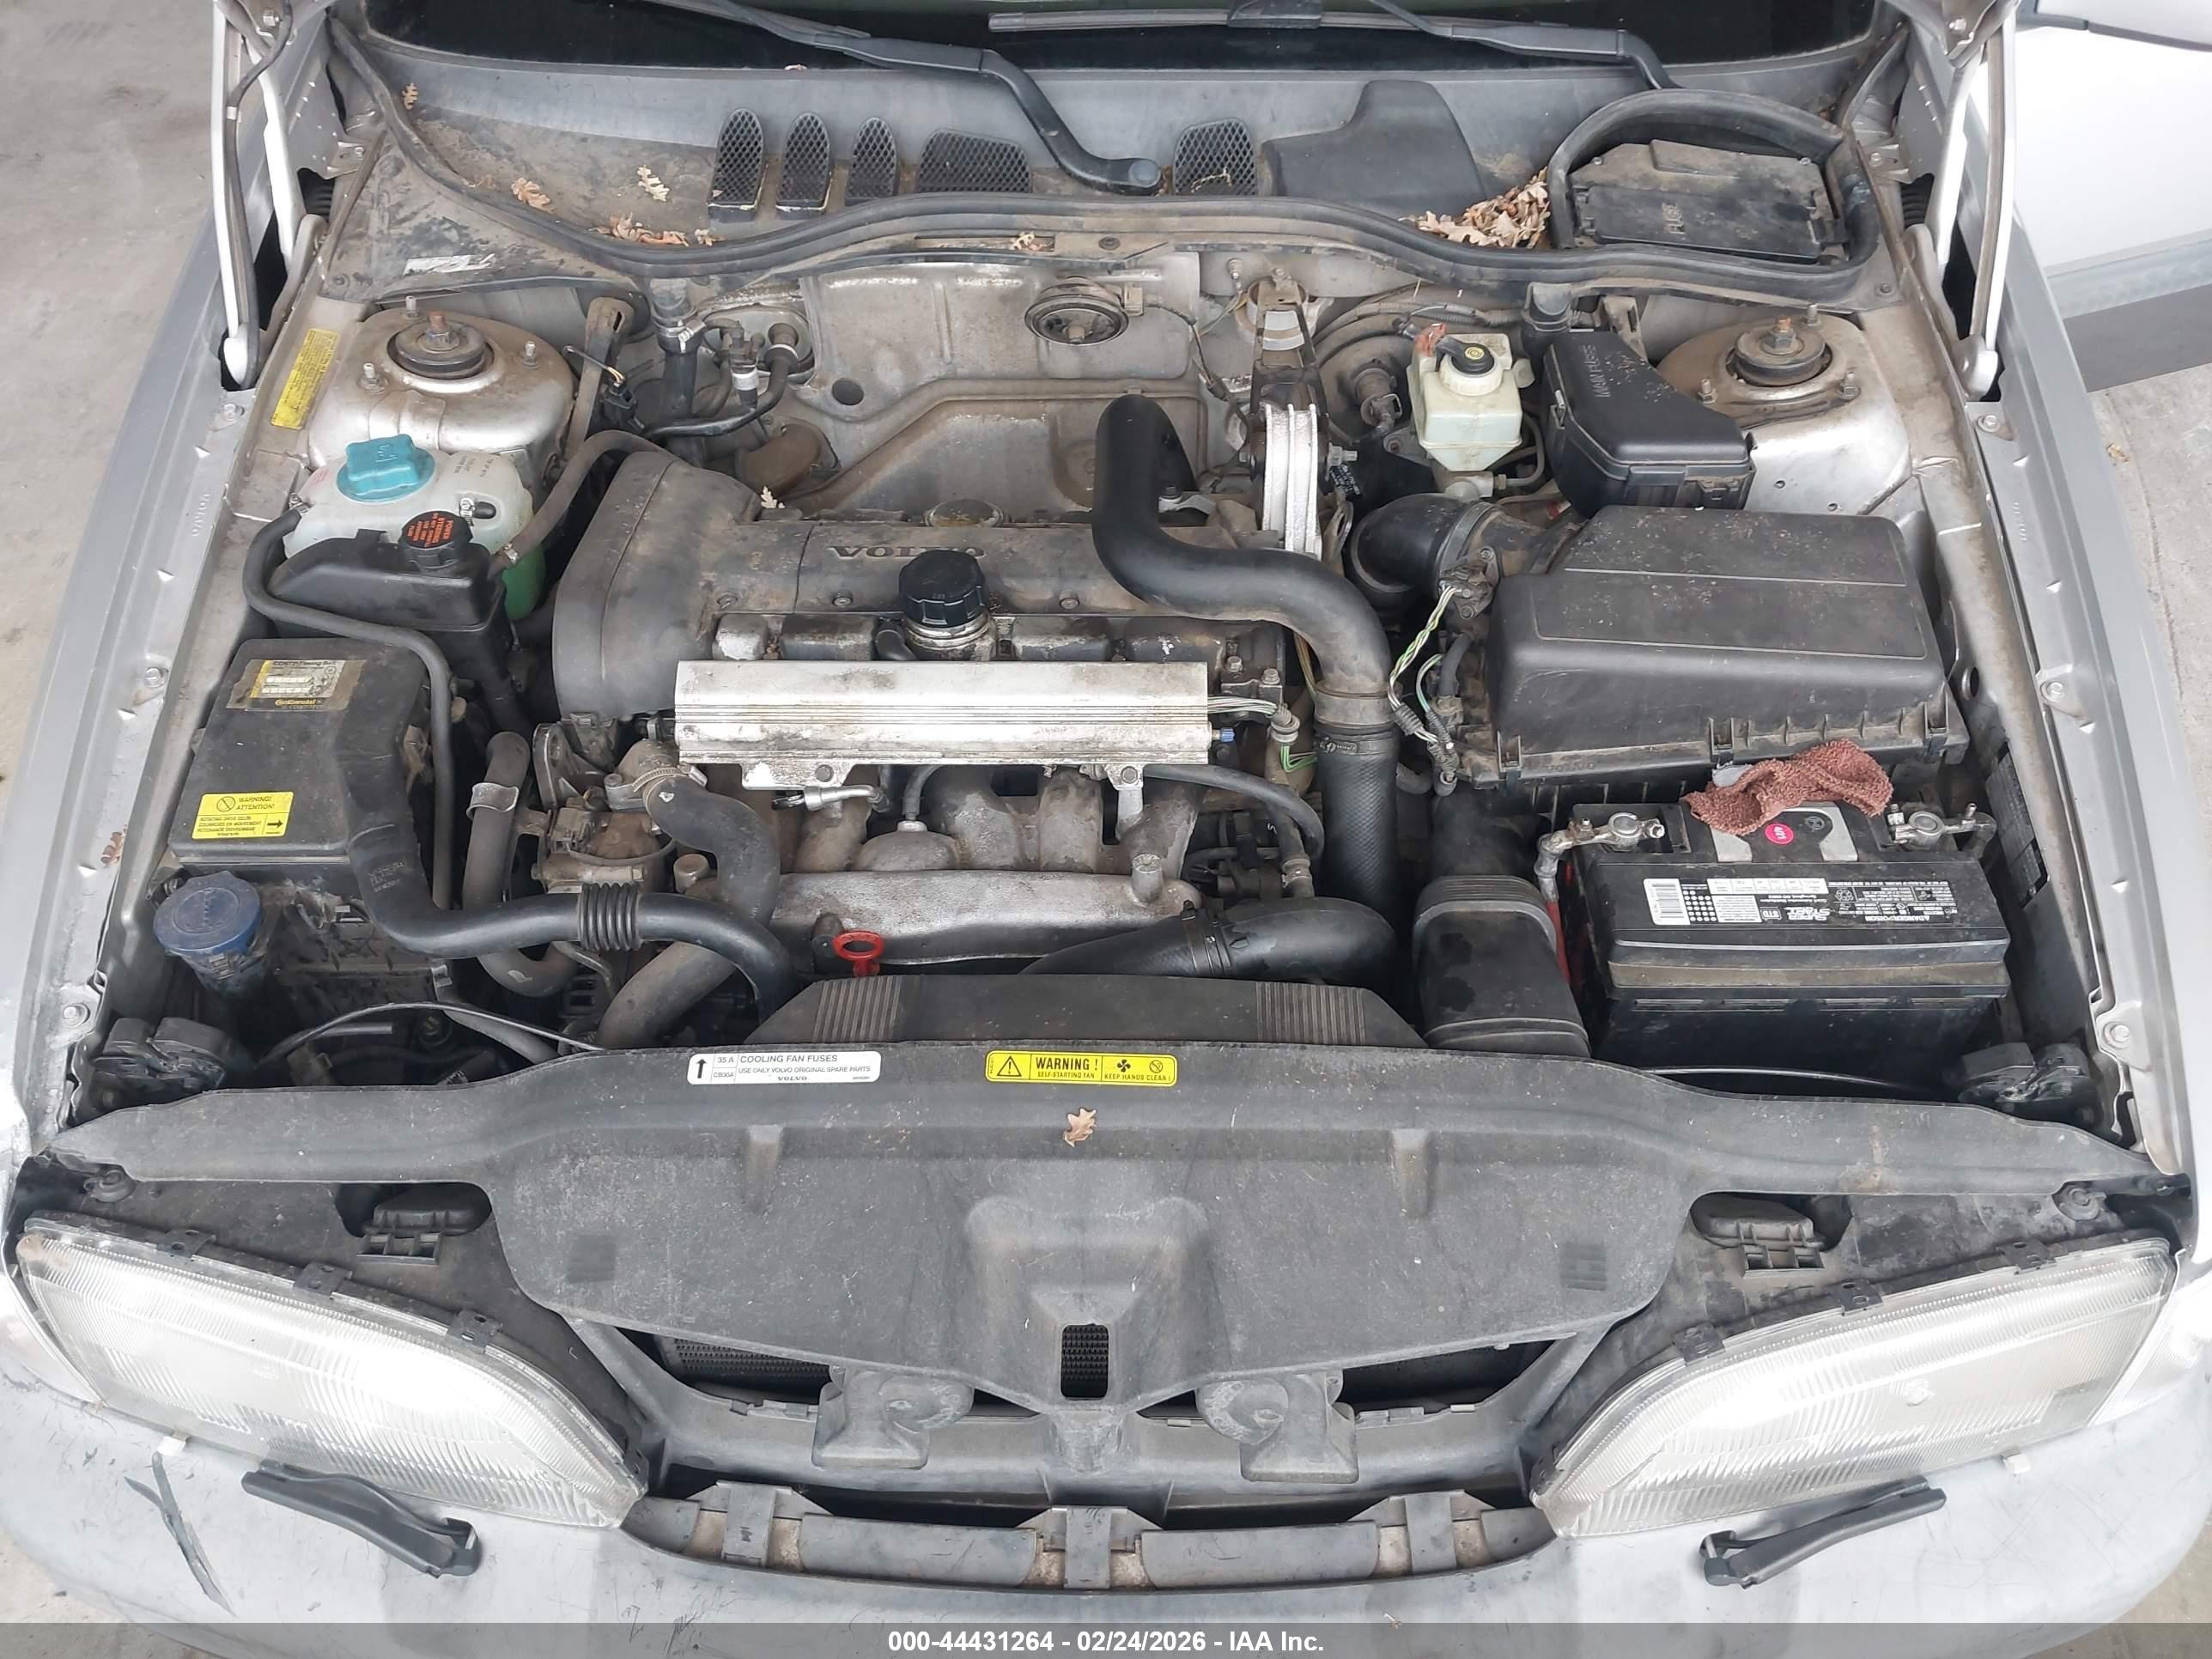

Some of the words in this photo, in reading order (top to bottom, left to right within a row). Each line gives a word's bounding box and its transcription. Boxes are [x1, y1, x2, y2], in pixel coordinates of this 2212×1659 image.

[786, 1054, 805, 1063] FAN
[806, 1054, 838, 1063] FUSES
[1036, 1057, 1091, 1071] WARNING
